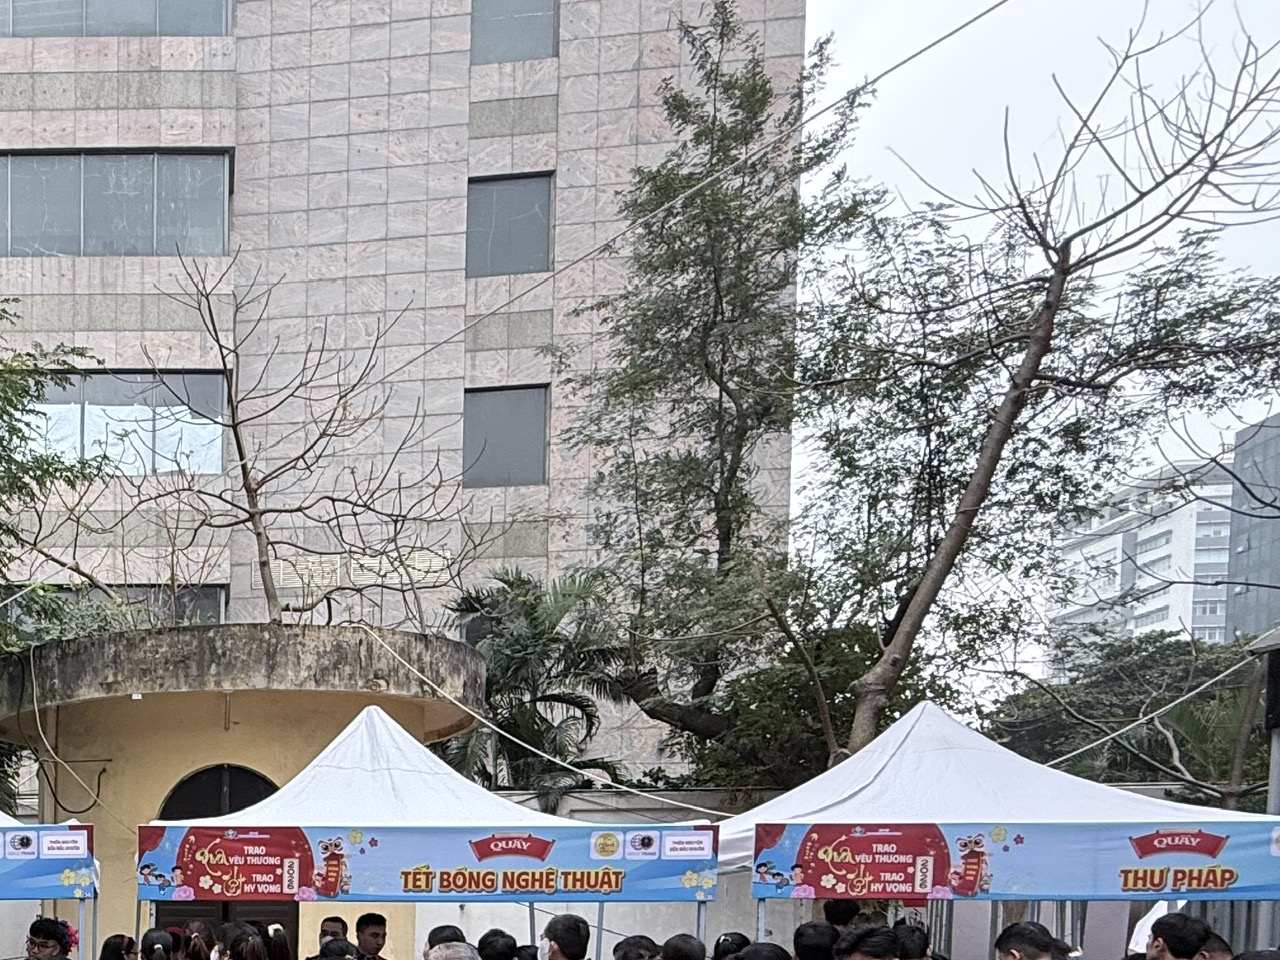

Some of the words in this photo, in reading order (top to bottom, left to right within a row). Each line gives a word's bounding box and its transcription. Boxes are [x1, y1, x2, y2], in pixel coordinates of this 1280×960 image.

[243, 846, 266, 855] TRAO
[872, 844, 897, 853] TRAO
[252, 874, 274, 882] TRAO
[287, 861, 295, 890] 2026
[400, 864, 434, 889] TẾT
[439, 866, 496, 889] BÓNG
[502, 867, 556, 893] NGHỆ
[560, 867, 624, 893] THUẬT
[880, 872, 905, 881] TRAO
[919, 859, 929, 890] 2026
[1120, 867, 1169, 888] THƯ
[1173, 865, 1236, 888] PHÁP
[244, 884, 256, 893] HY
[870, 882, 884, 892] HY
